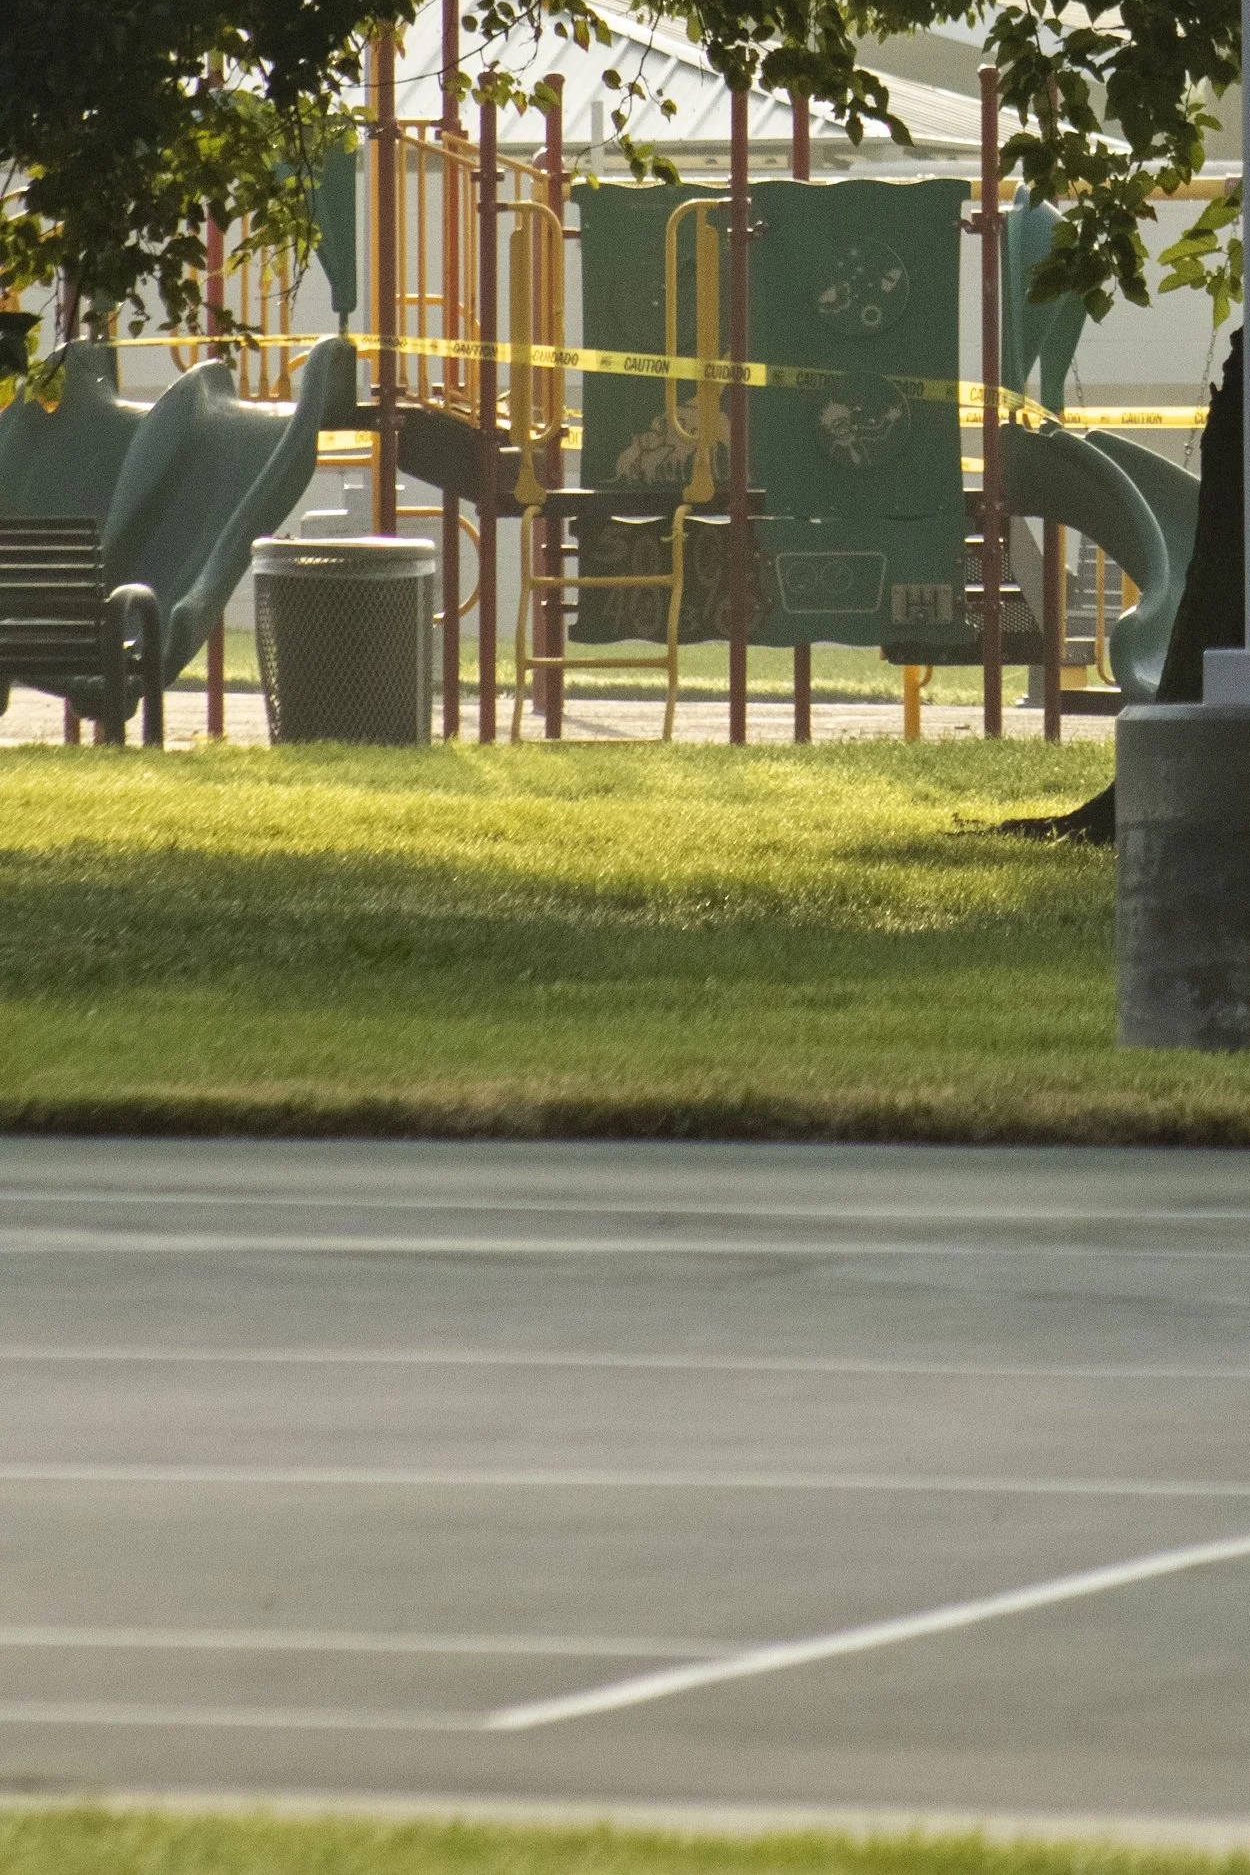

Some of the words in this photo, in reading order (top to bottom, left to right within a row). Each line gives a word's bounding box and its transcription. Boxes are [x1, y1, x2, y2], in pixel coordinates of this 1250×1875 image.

[532, 350, 579, 366] CUIDADO
[623, 356, 671, 374] CAUTION
[704, 362, 751, 382] CUIDADO
[1121, 412, 1163, 425] CAUTION
